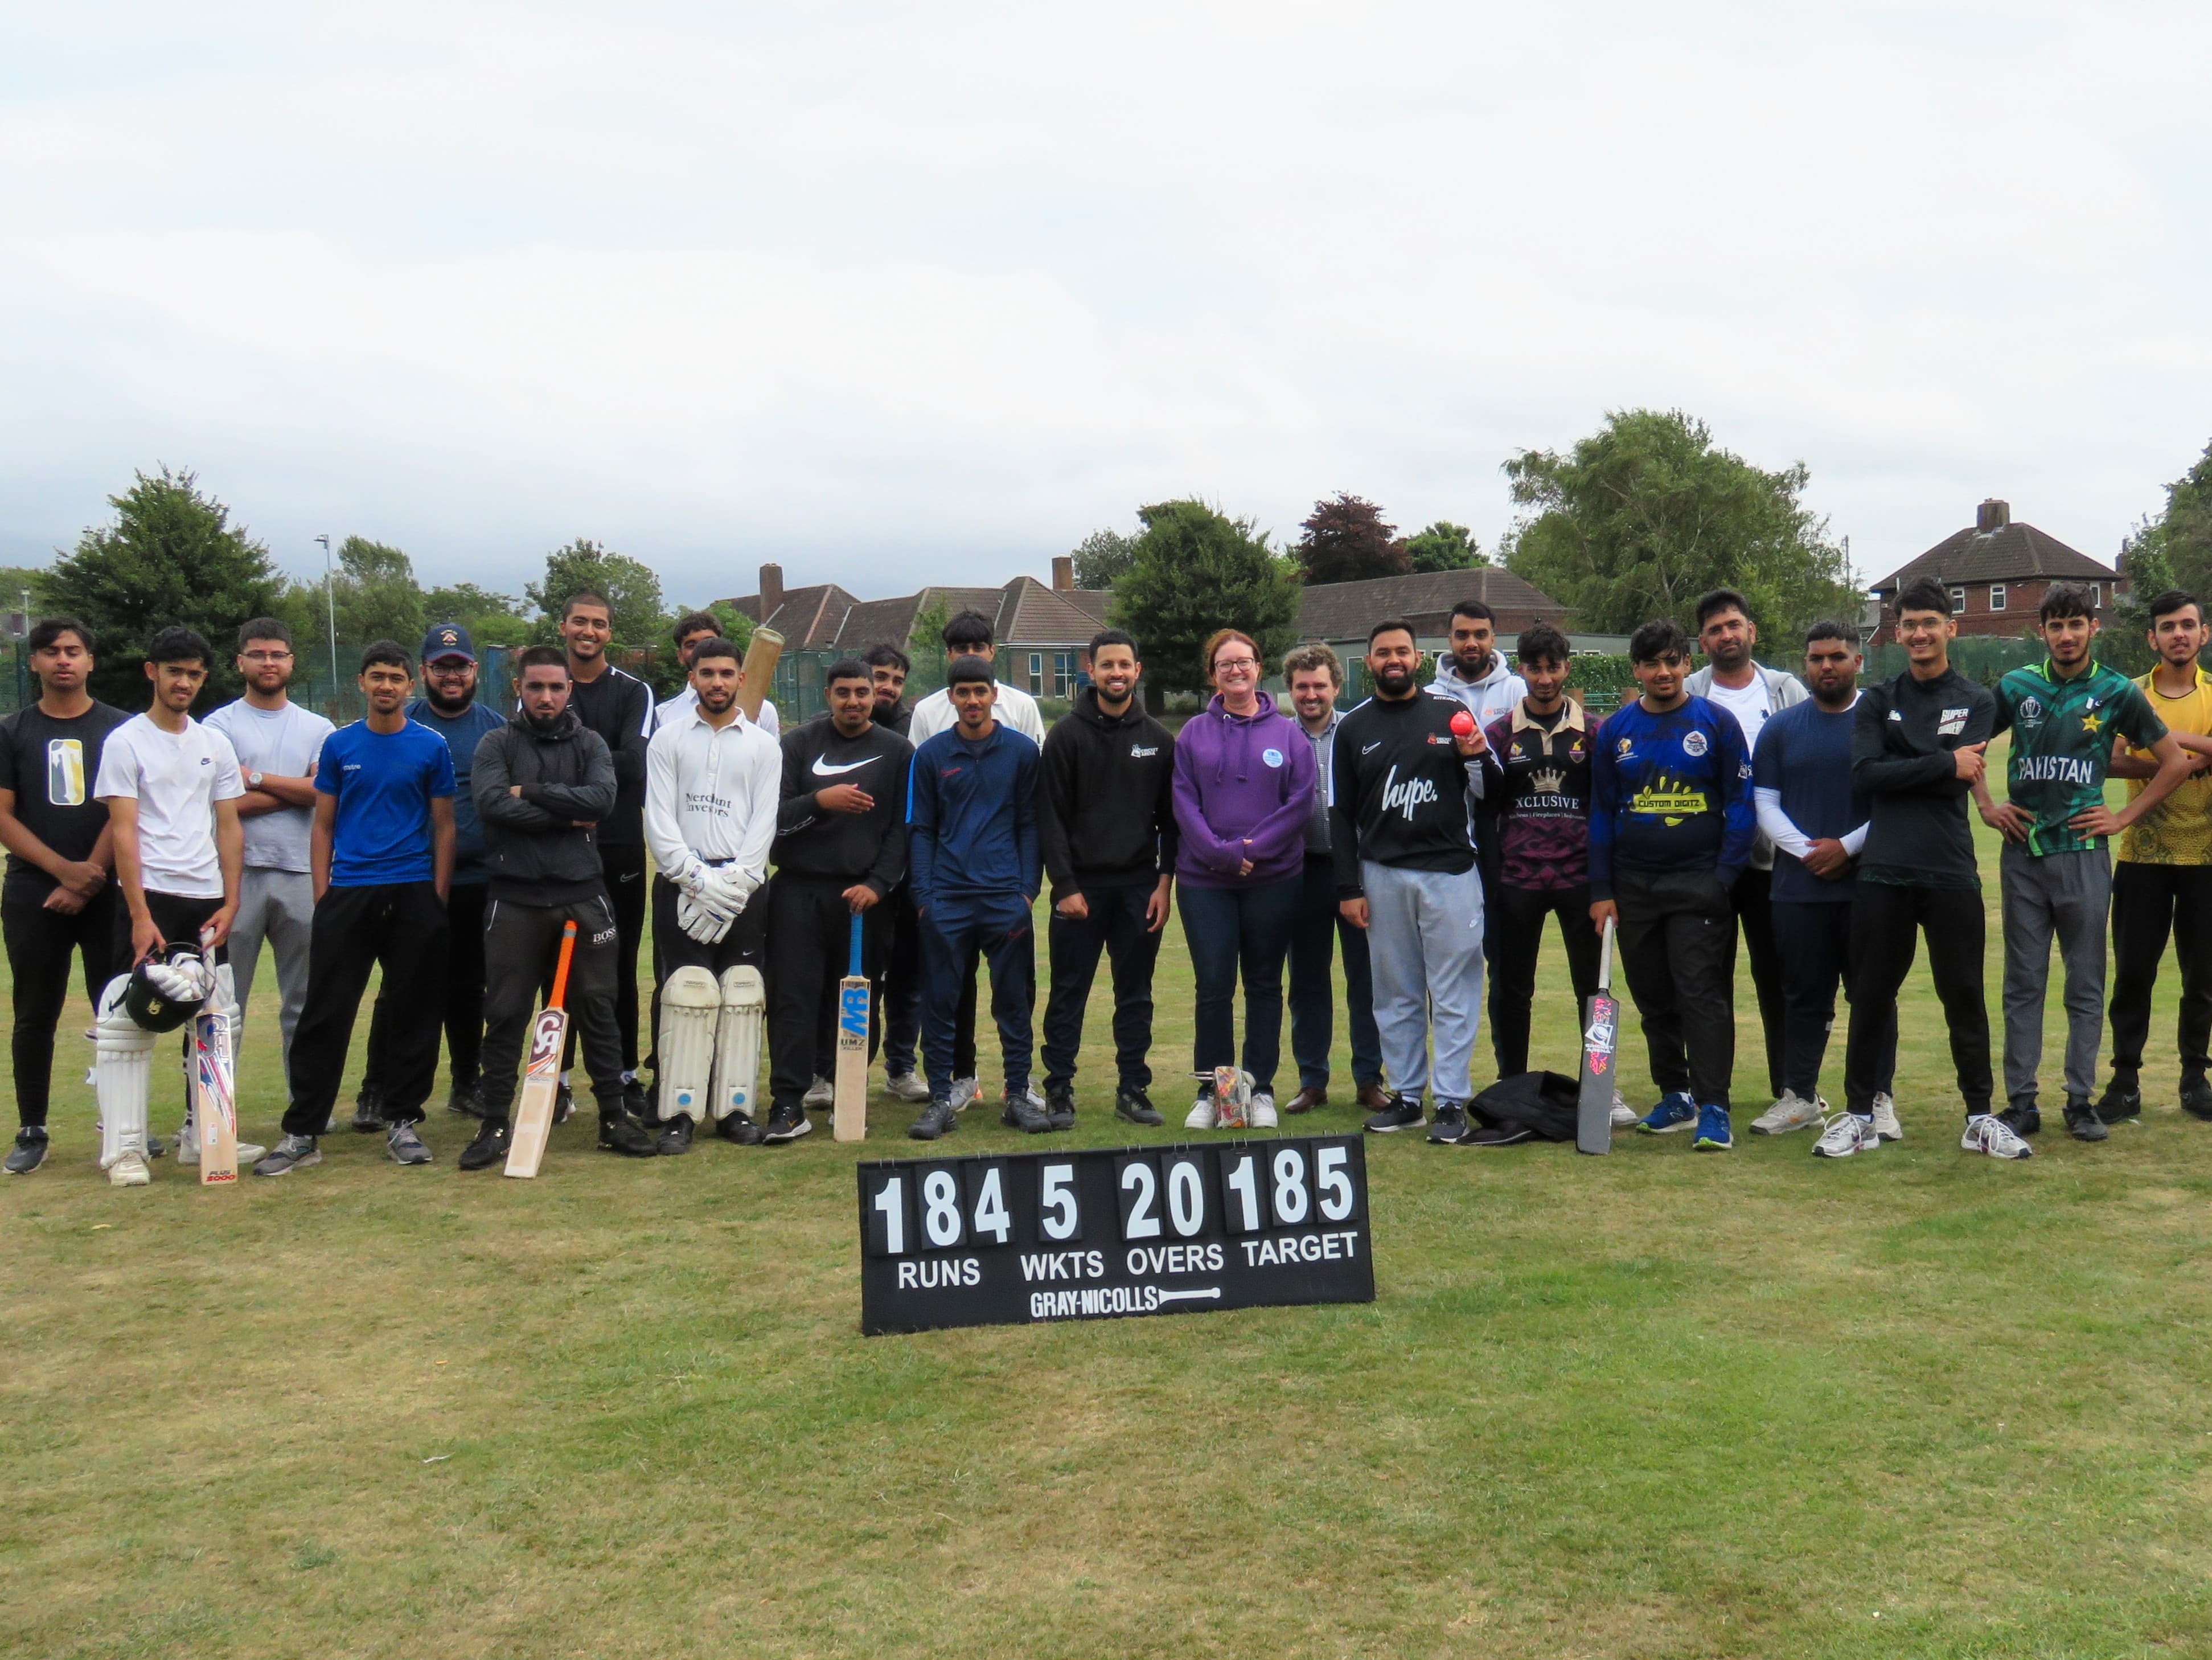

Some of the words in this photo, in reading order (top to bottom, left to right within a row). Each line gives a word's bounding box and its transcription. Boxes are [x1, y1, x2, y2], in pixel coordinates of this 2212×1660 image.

[1940, 708, 1968, 723] SUPER
[2018, 756, 2092, 784] PAKISTAN
[687, 804, 728, 817] Invesors
[875, 1168, 1012, 1253] 184
[1041, 1163, 1078, 1240] 5
[1121, 1161, 1204, 1239] 20
[1228, 1146, 1354, 1232] 185
[898, 1258, 980, 1289] RUNS
[1021, 1251, 1103, 1282] WKTS
[1127, 1243, 1223, 1276] OVERS
[1241, 1231, 1358, 1267] TARGET
[1030, 1285, 1159, 1318] GRAY-NICOLLS
